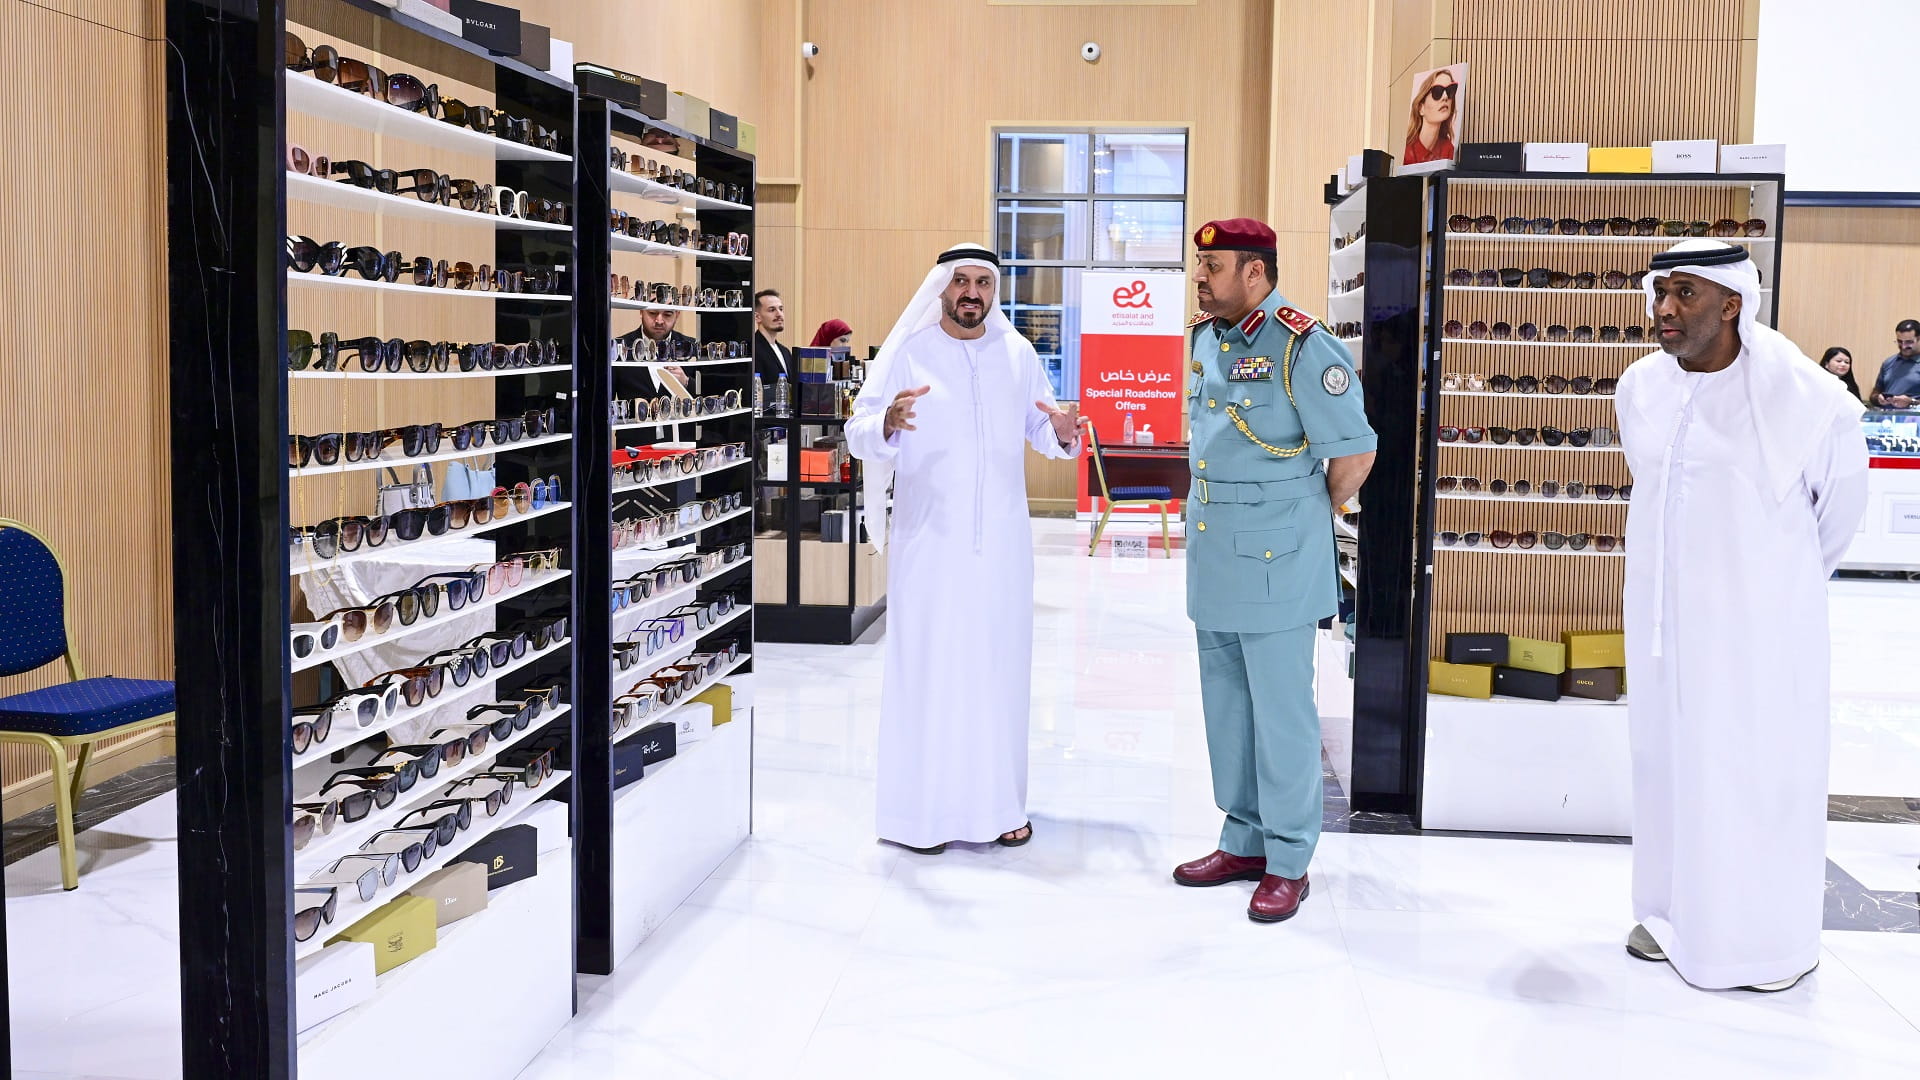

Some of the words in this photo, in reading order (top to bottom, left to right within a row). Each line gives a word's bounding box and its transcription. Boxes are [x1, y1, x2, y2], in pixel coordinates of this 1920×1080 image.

[465, 17, 497, 30] BVLGARI
[1100, 370, 1135, 383] خاص
[1138, 370, 1172, 383] عرض
[1086, 388, 1123, 399] Special
[1125, 389, 1176, 398] Roadshow
[1115, 401, 1147, 410] Offers
[444, 897, 457, 905] Dior
[313, 989, 329, 999] MARC
[330, 978, 352, 992] JACOBS
